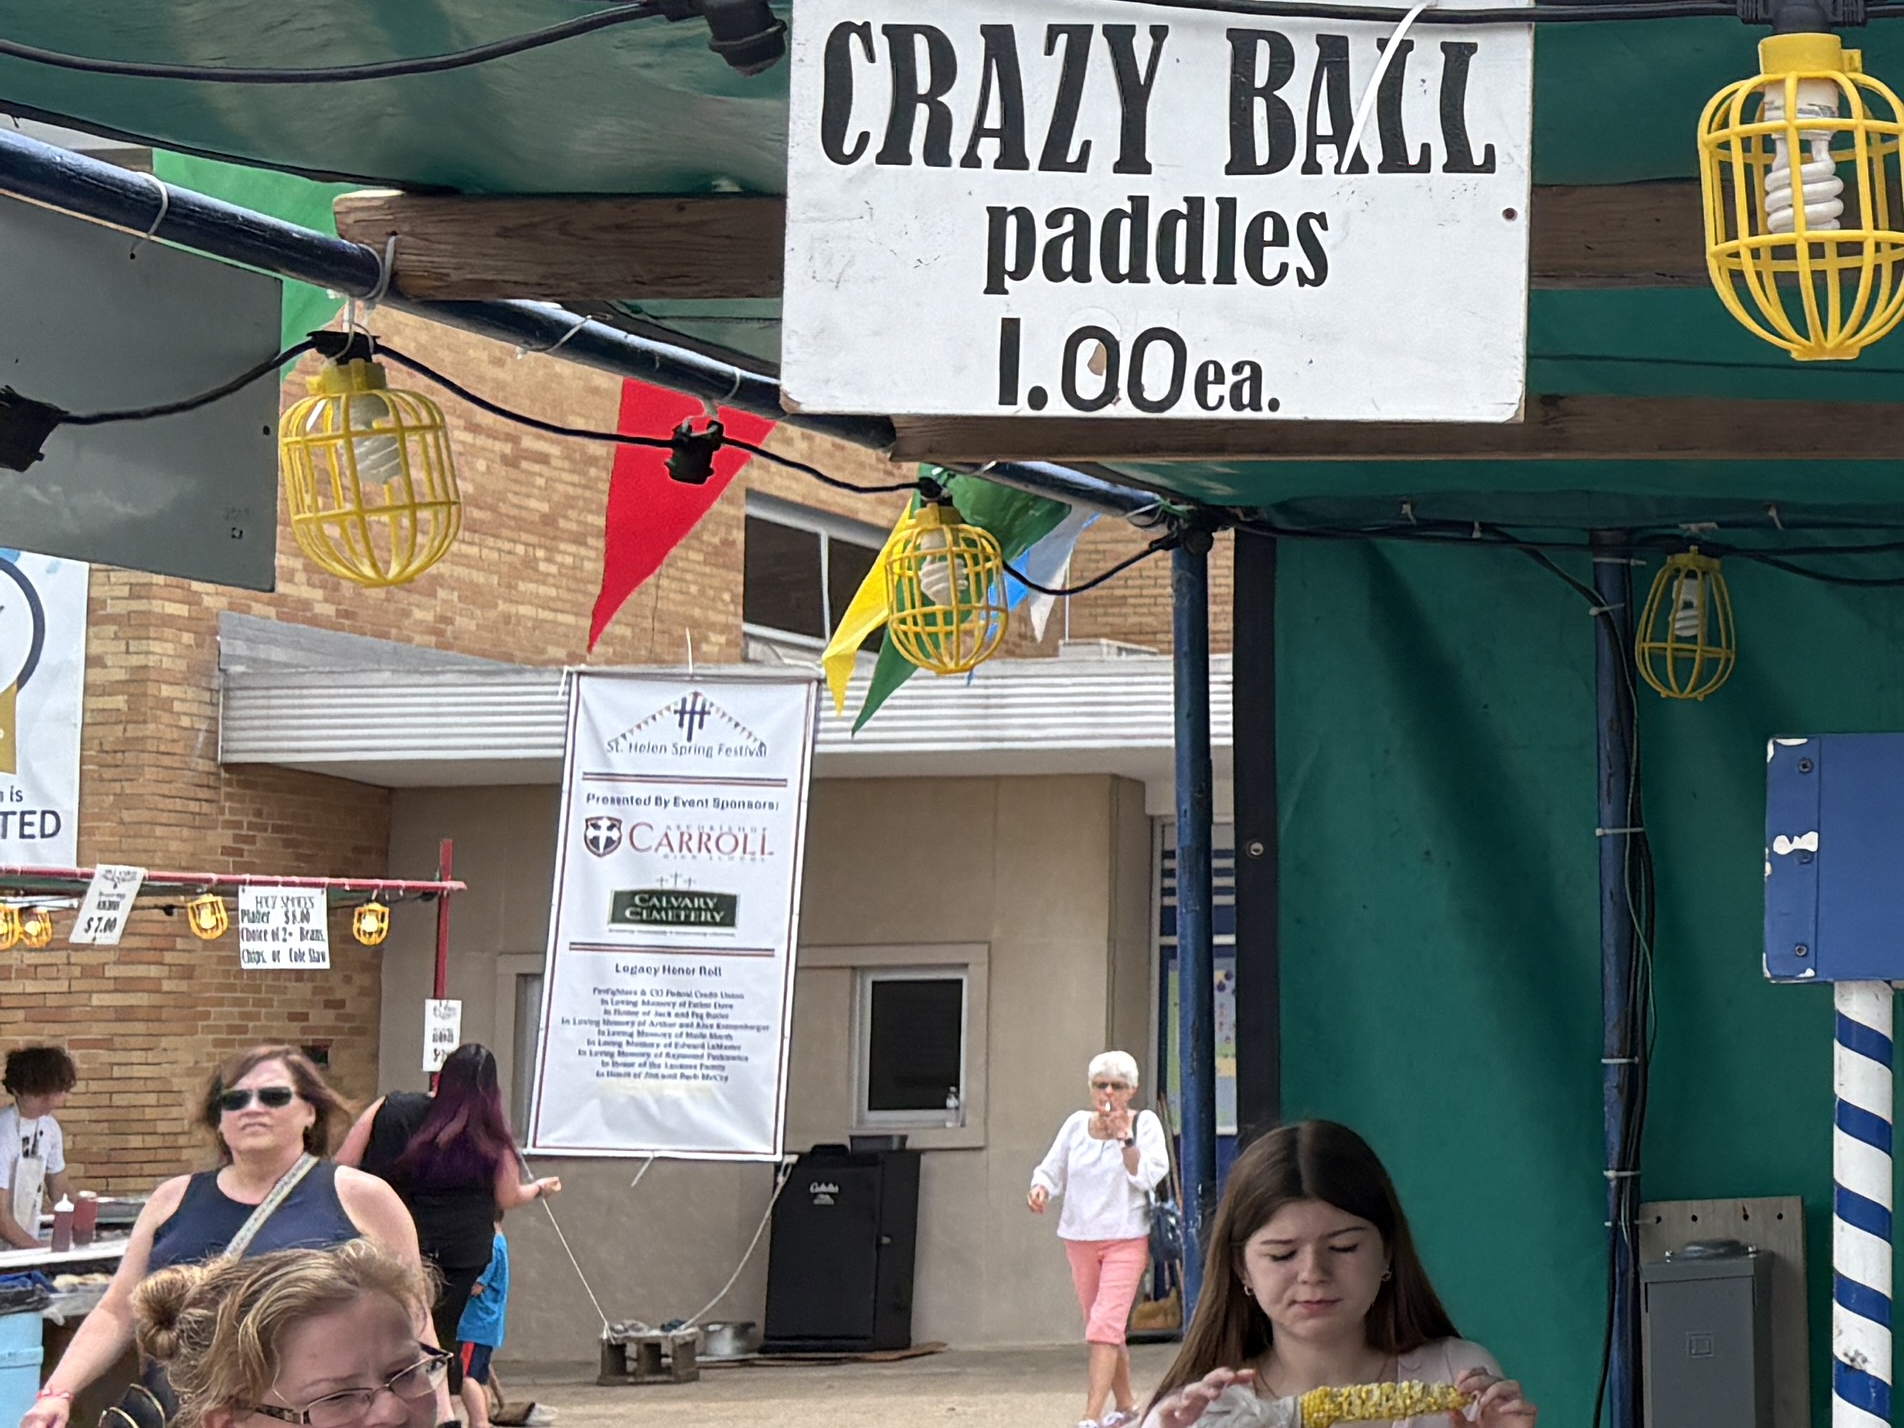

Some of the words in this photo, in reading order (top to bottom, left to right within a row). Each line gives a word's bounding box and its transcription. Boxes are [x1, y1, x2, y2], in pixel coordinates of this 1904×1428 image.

[819, 20, 1169, 174] CRAZY
[1224, 27, 1496, 176] BALL
[983, 194, 1330, 294] paddles
[607, 740, 623, 753] St.
[629, 742, 666, 754] Helen
[672, 743, 713, 758] Spring
[718, 743, 767, 758] Festival
[10, 785, 24, 803] is
[586, 793, 650, 806] Presented
[655, 795, 670, 809] By
[673, 796, 708, 809] Event
[629, 822, 774, 856] CARROLL
[634, 894, 718, 908] CALVARY
[625, 907, 724, 922] CEMETERY
[615, 963, 660, 977] Legacy
[662, 965, 695, 976] Honor
[700, 966, 722, 977] Roll
